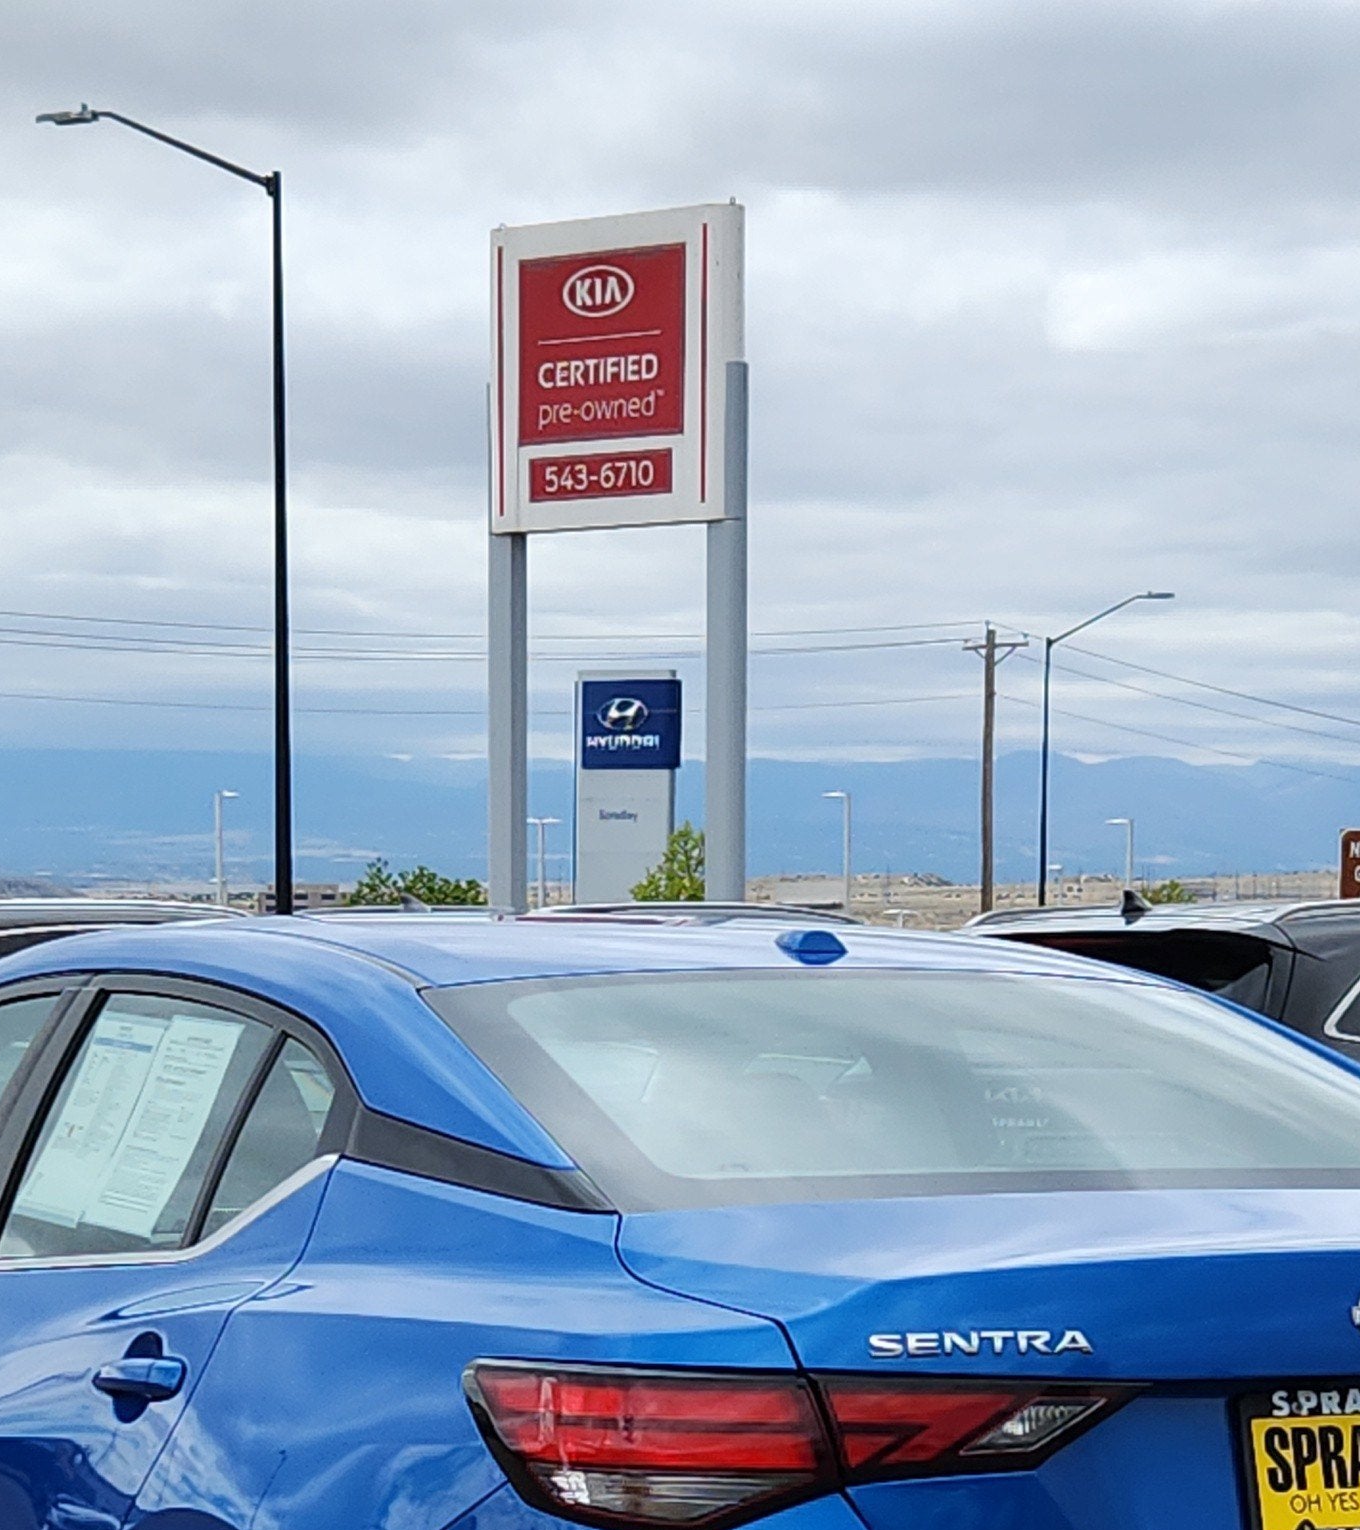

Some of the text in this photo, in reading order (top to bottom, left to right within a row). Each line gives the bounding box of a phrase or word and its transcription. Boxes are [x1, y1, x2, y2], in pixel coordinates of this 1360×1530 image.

[575, 276, 622, 307] KIA
[538, 353, 658, 389] CERTIFIED
[544, 460, 654, 493] 543-6710
[585, 734, 660, 751] HYUNDAI
[869, 1330, 1093, 1358] SENTRA
[1290, 1494, 1322, 1514] OH
[1326, 1492, 1360, 1511] YES
